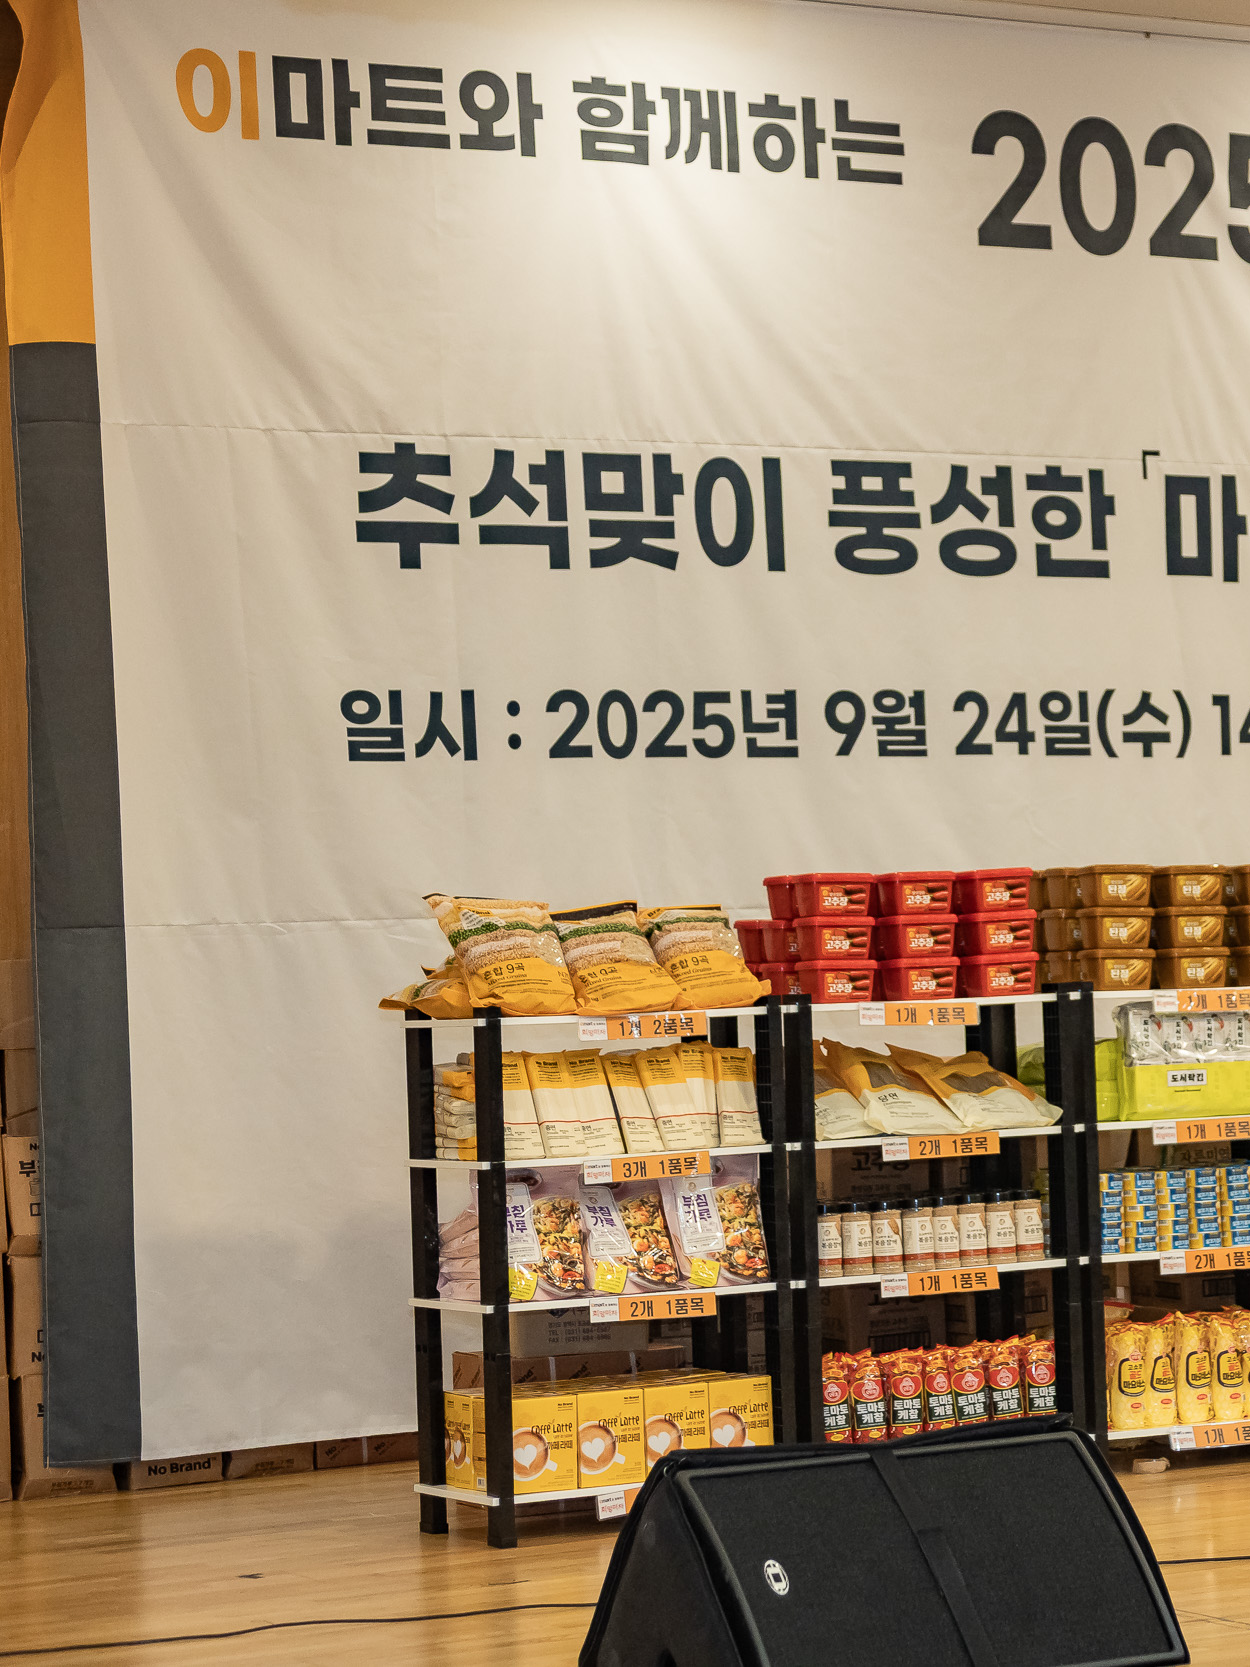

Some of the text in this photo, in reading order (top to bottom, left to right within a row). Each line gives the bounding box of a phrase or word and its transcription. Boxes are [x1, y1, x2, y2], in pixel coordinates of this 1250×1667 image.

[176, 48, 543, 157] 이마트와
[572, 76, 905, 185] 함께하는
[355, 441, 786, 571] 추석맞이
[827, 459, 1116, 580] 풍성한
[340, 690, 480, 763] 일시
[545, 689, 799, 761] 2025년
[824, 689, 929, 757] 9월
[953, 689, 1192, 759] 24일(수)
[823, 896, 848, 906] 고추장
[905, 894, 931, 904] 고추장
[986, 892, 1010, 901] 고추장
[825, 940, 850, 949] 고추장
[909, 937, 934, 947] 고추장
[990, 935, 1014, 944] 고추장
[827, 983, 852, 993] 고추장
[912, 980, 936, 990] 고추장
[990, 977, 1015, 986] 고추장
[1218, 993, 1250, 1008] 1품목
[897, 1008, 964, 1022] 1개 1품목
[653, 1017, 694, 1035] 2품목
[1171, 1073, 1204, 1083] 도시락김
[1187, 1122, 1249, 1138] 1개 1품목
[919, 1136, 988, 1156] 2개 1품목
[623, 1157, 697, 1178] 3개 1품목
[682, 1194, 708, 1208] 부침
[585, 1204, 612, 1218] 부침
[592, 1216, 616, 1228] 가루
[1195, 1254, 1215, 1270] 2개
[919, 1272, 988, 1292] 1개 1품목
[631, 1298, 704, 1317] 2개 1품목
[992, 1388, 1020, 1401] 토마토
[1029, 1386, 1056, 1398] 토마토
[893, 1399, 921, 1411] 토마토
[958, 1392, 986, 1407] 토마토
[997, 1399, 1018, 1411] 케찹
[1034, 1396, 1054, 1407] 케찹
[898, 1409, 919, 1420] 케찹
[963, 1404, 984, 1415] 케찹
[1205, 1428, 1223, 1443] 1개
[147, 1457, 211, 1477] No Brand
